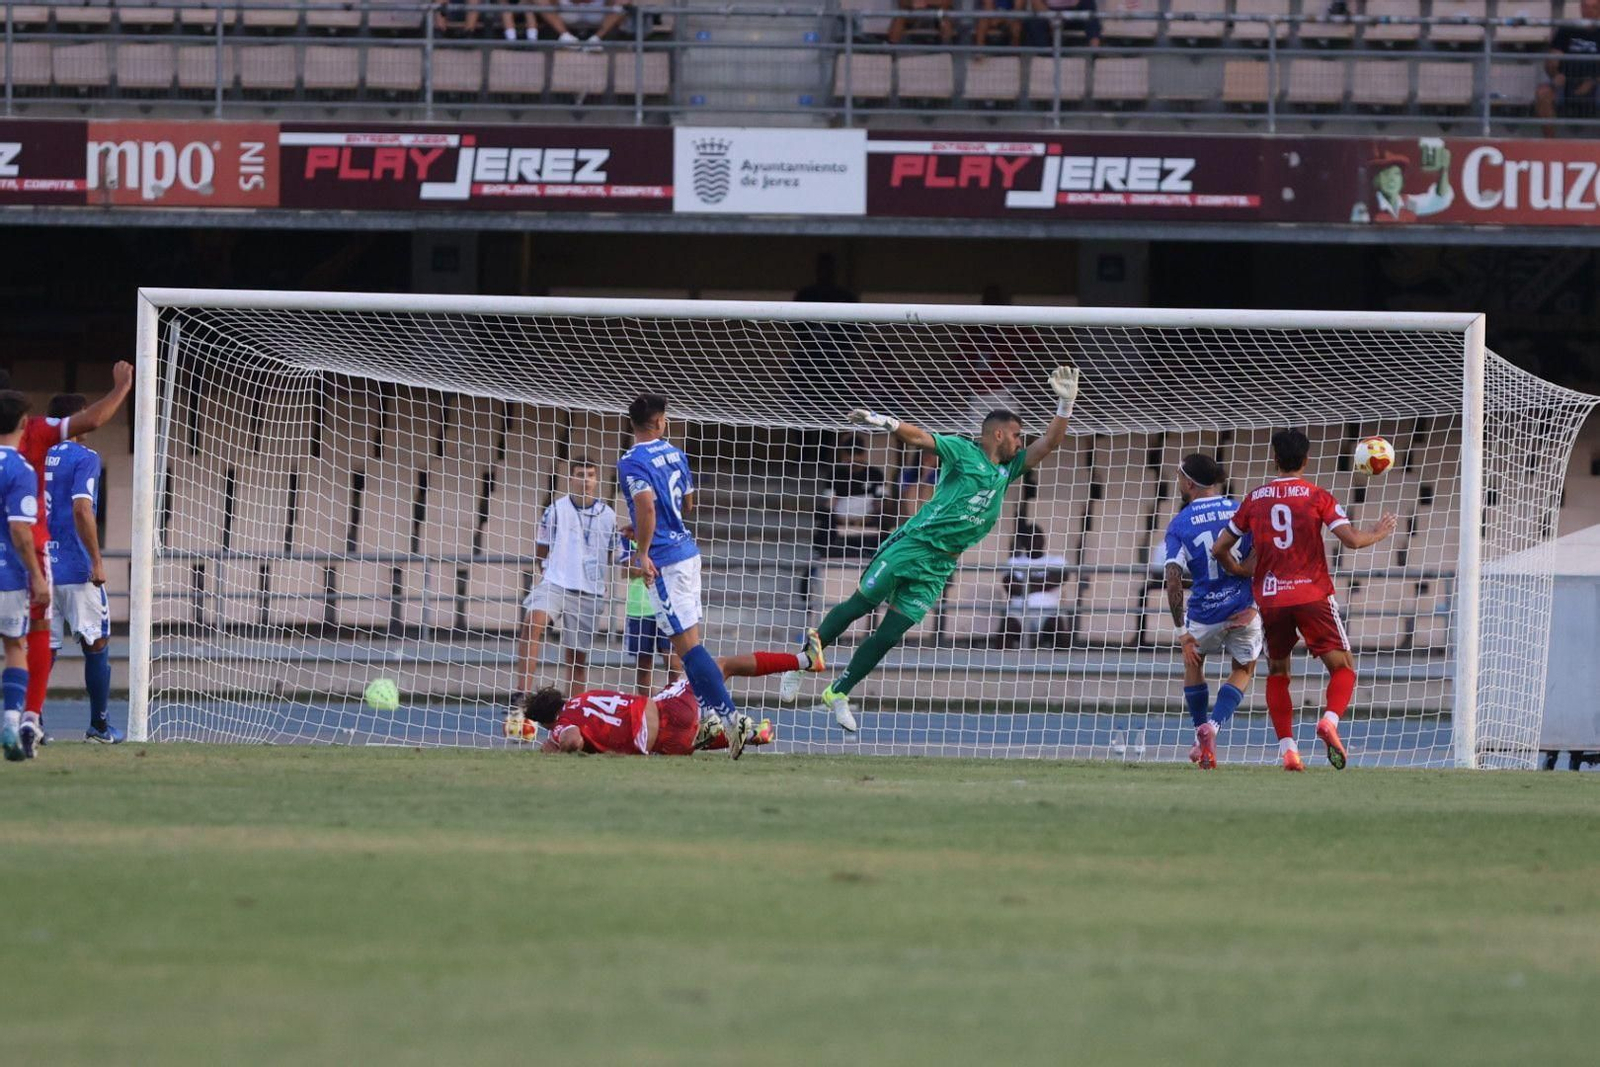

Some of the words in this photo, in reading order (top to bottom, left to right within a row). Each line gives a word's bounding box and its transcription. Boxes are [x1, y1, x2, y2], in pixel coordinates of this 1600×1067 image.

[239, 142, 265, 191] SIN
[305, 146, 444, 180] PLAY
[740, 159, 847, 174] Ayuntamiento
[890, 154, 1031, 188] PLAY
[1462, 146, 1600, 211] Cruz
[740, 174, 758, 187] de
[762, 175, 800, 189] Jerez
[1288, 486, 1310, 497] MESA
[1190, 511, 1216, 525] CARLOS
[1271, 504, 1294, 549] 9
[583, 695, 628, 728] 14
